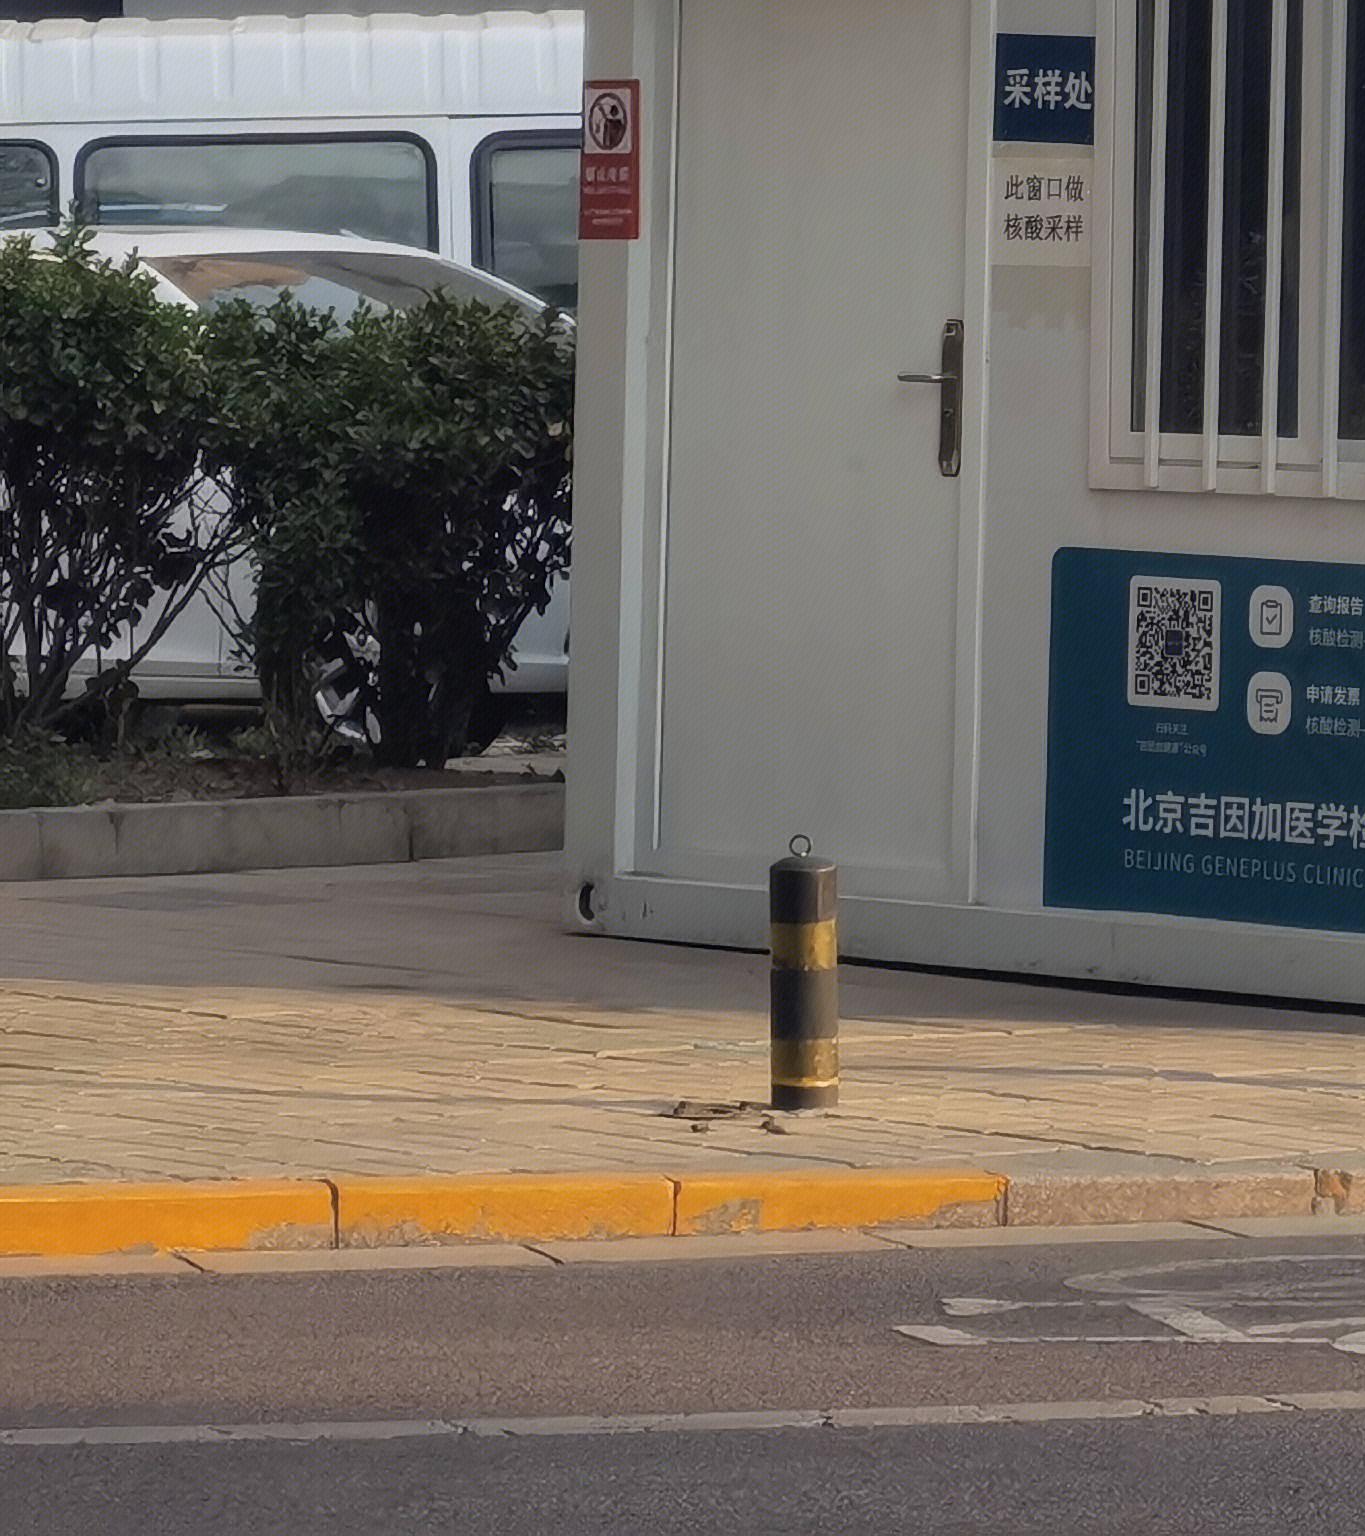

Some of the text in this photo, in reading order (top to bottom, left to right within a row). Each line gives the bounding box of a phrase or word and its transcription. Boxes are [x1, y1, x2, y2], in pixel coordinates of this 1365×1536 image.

[1003, 68, 1093, 111] 采样处
[1003, 174, 1085, 203] 此窗口做
[1003, 213, 1084, 243] 核酸采样
[1308, 594, 1364, 617] 查询报告
[1306, 684, 1361, 707] 申请发票
[1124, 848, 1195, 874] BEIJING
[1202, 855, 1297, 883] GENEPLUS
